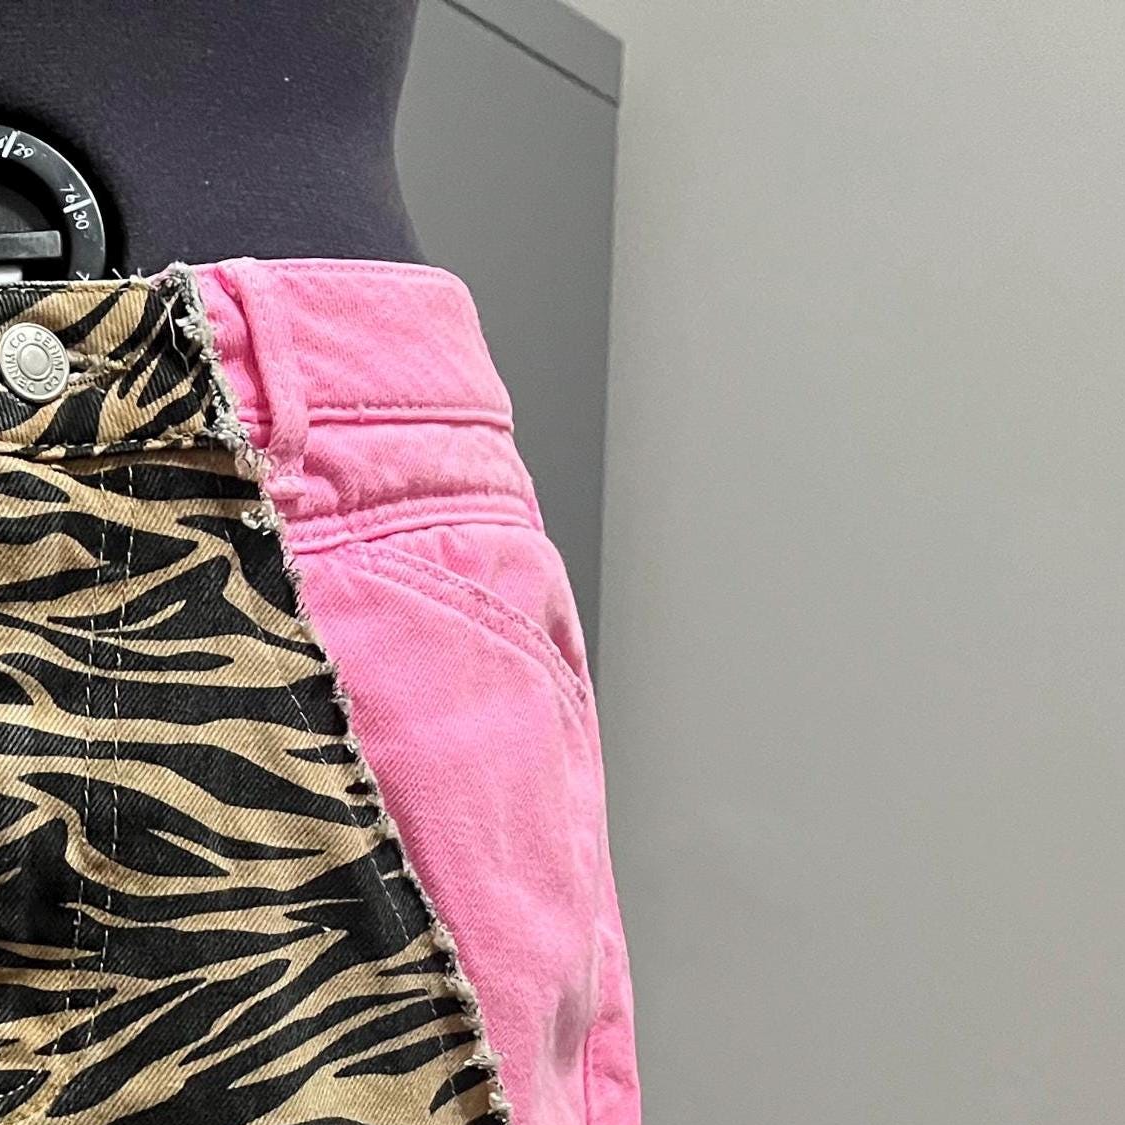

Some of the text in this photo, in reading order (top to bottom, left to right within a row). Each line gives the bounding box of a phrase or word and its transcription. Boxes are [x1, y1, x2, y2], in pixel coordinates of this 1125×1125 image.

[13, 142, 34, 159] 29
[59, 183, 89, 231] 76 30
[9, 332, 27, 349] CO
[34, 331, 64, 392] DENIM CO
